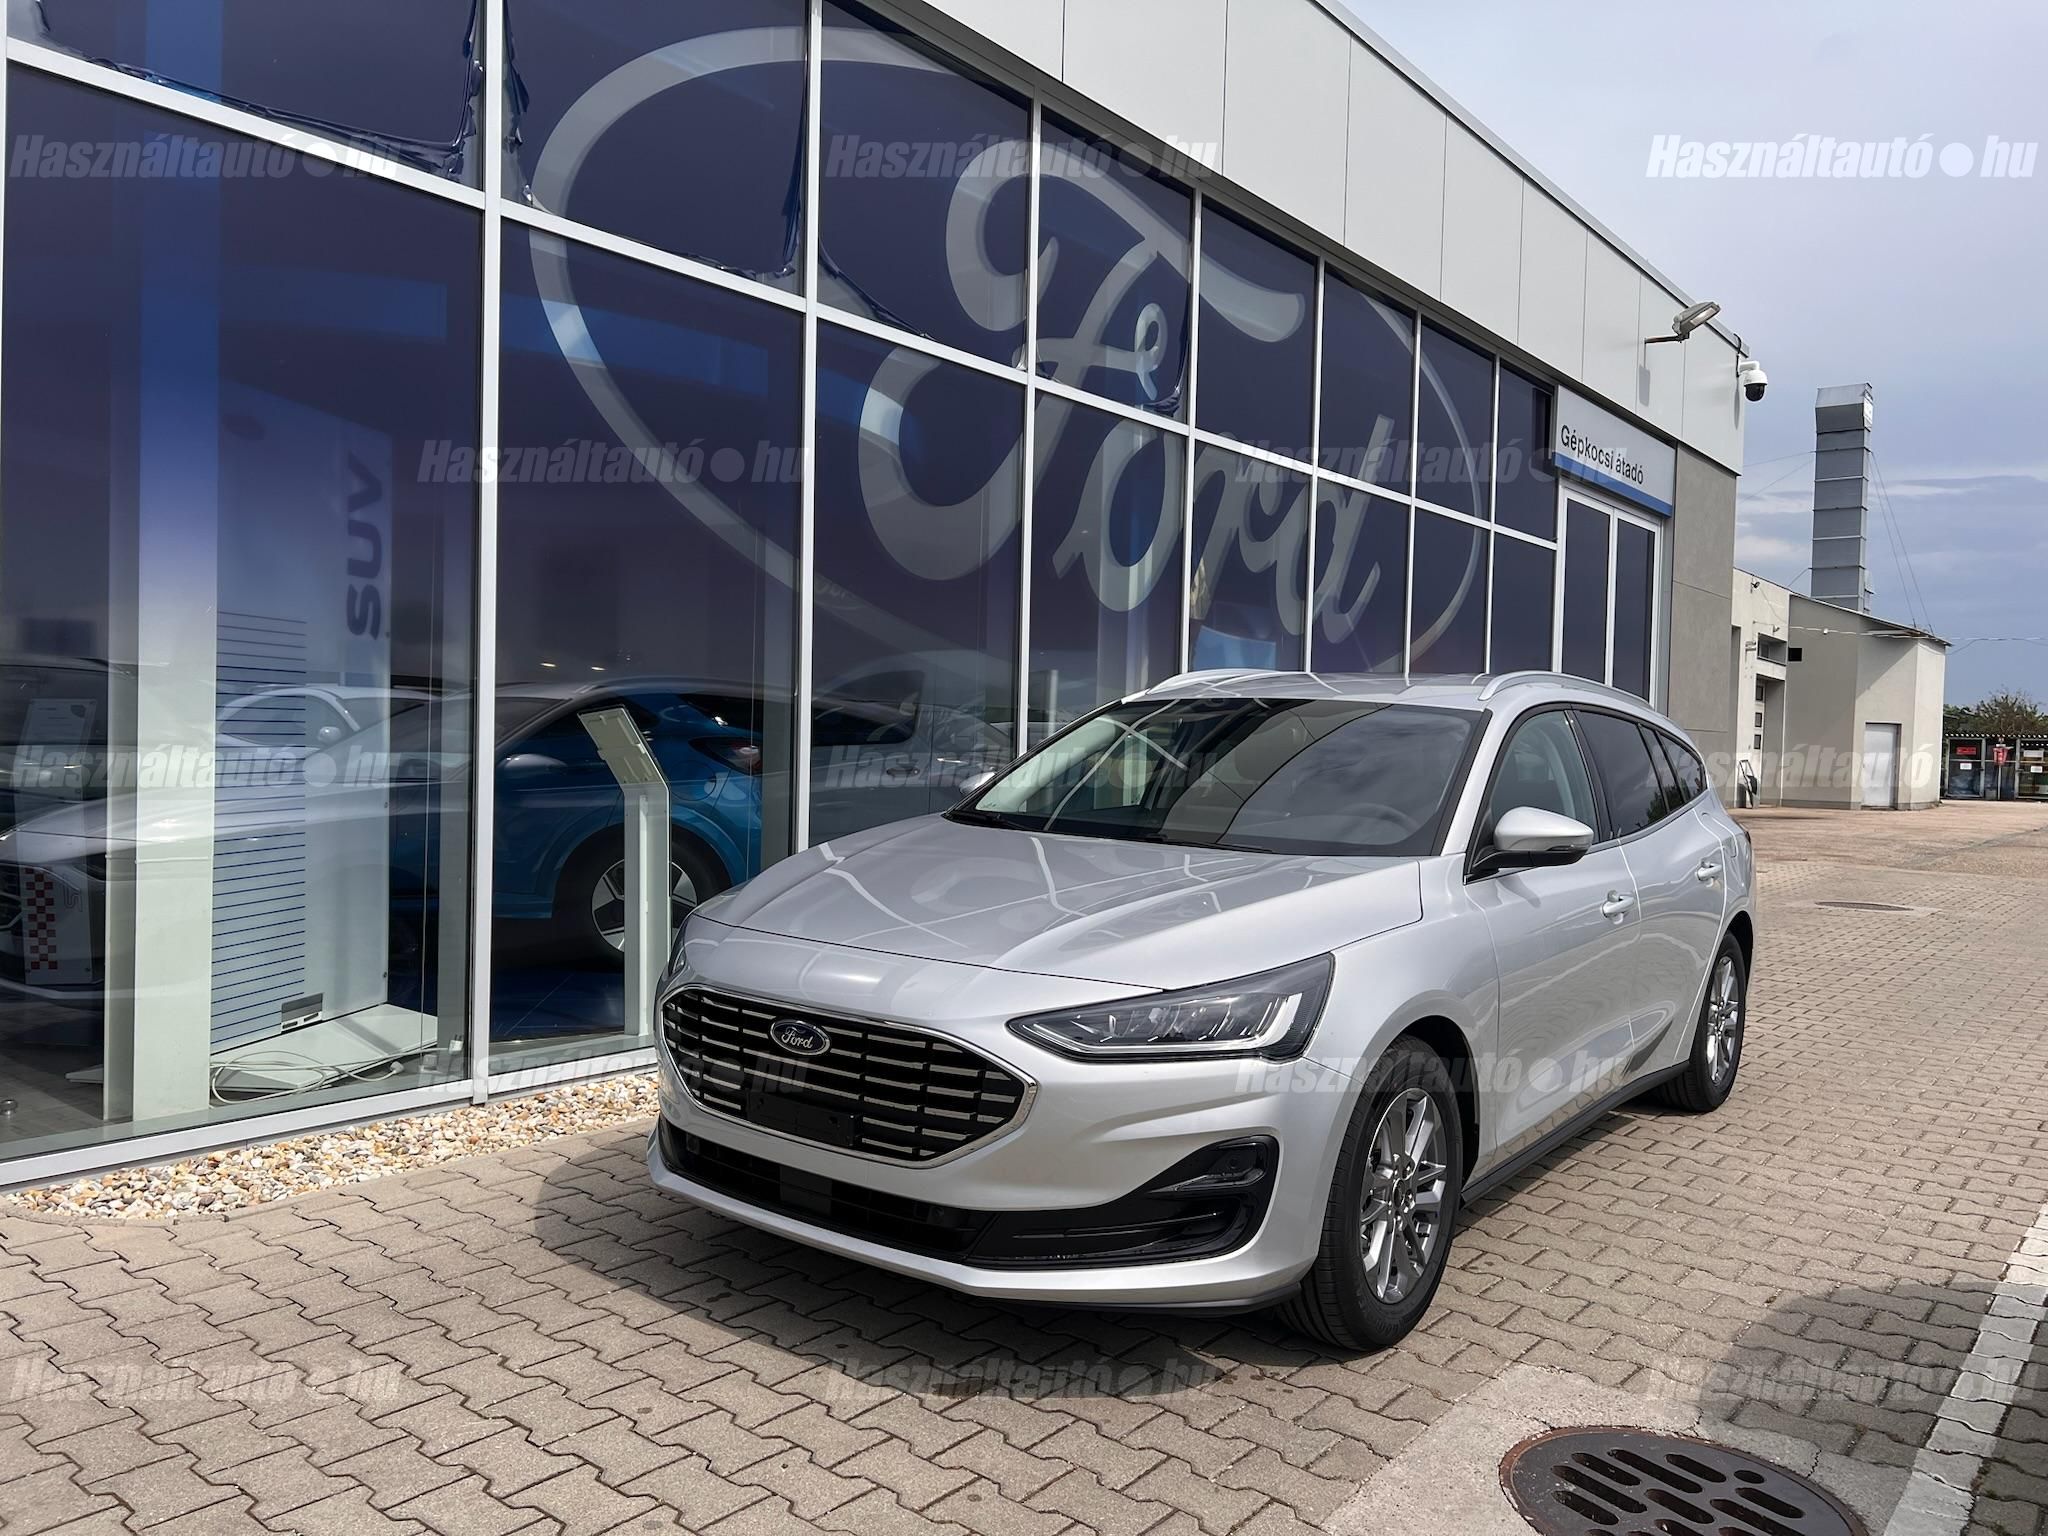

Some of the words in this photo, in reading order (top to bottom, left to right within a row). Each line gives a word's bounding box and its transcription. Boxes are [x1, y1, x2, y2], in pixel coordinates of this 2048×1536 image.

[858, 138, 1395, 645] Ford
[1561, 425, 1613, 470] Gépkocsi
[1616, 454, 1644, 484] átadó
[346, 450, 383, 641] SUV
[781, 1026, 814, 1049] Ford
